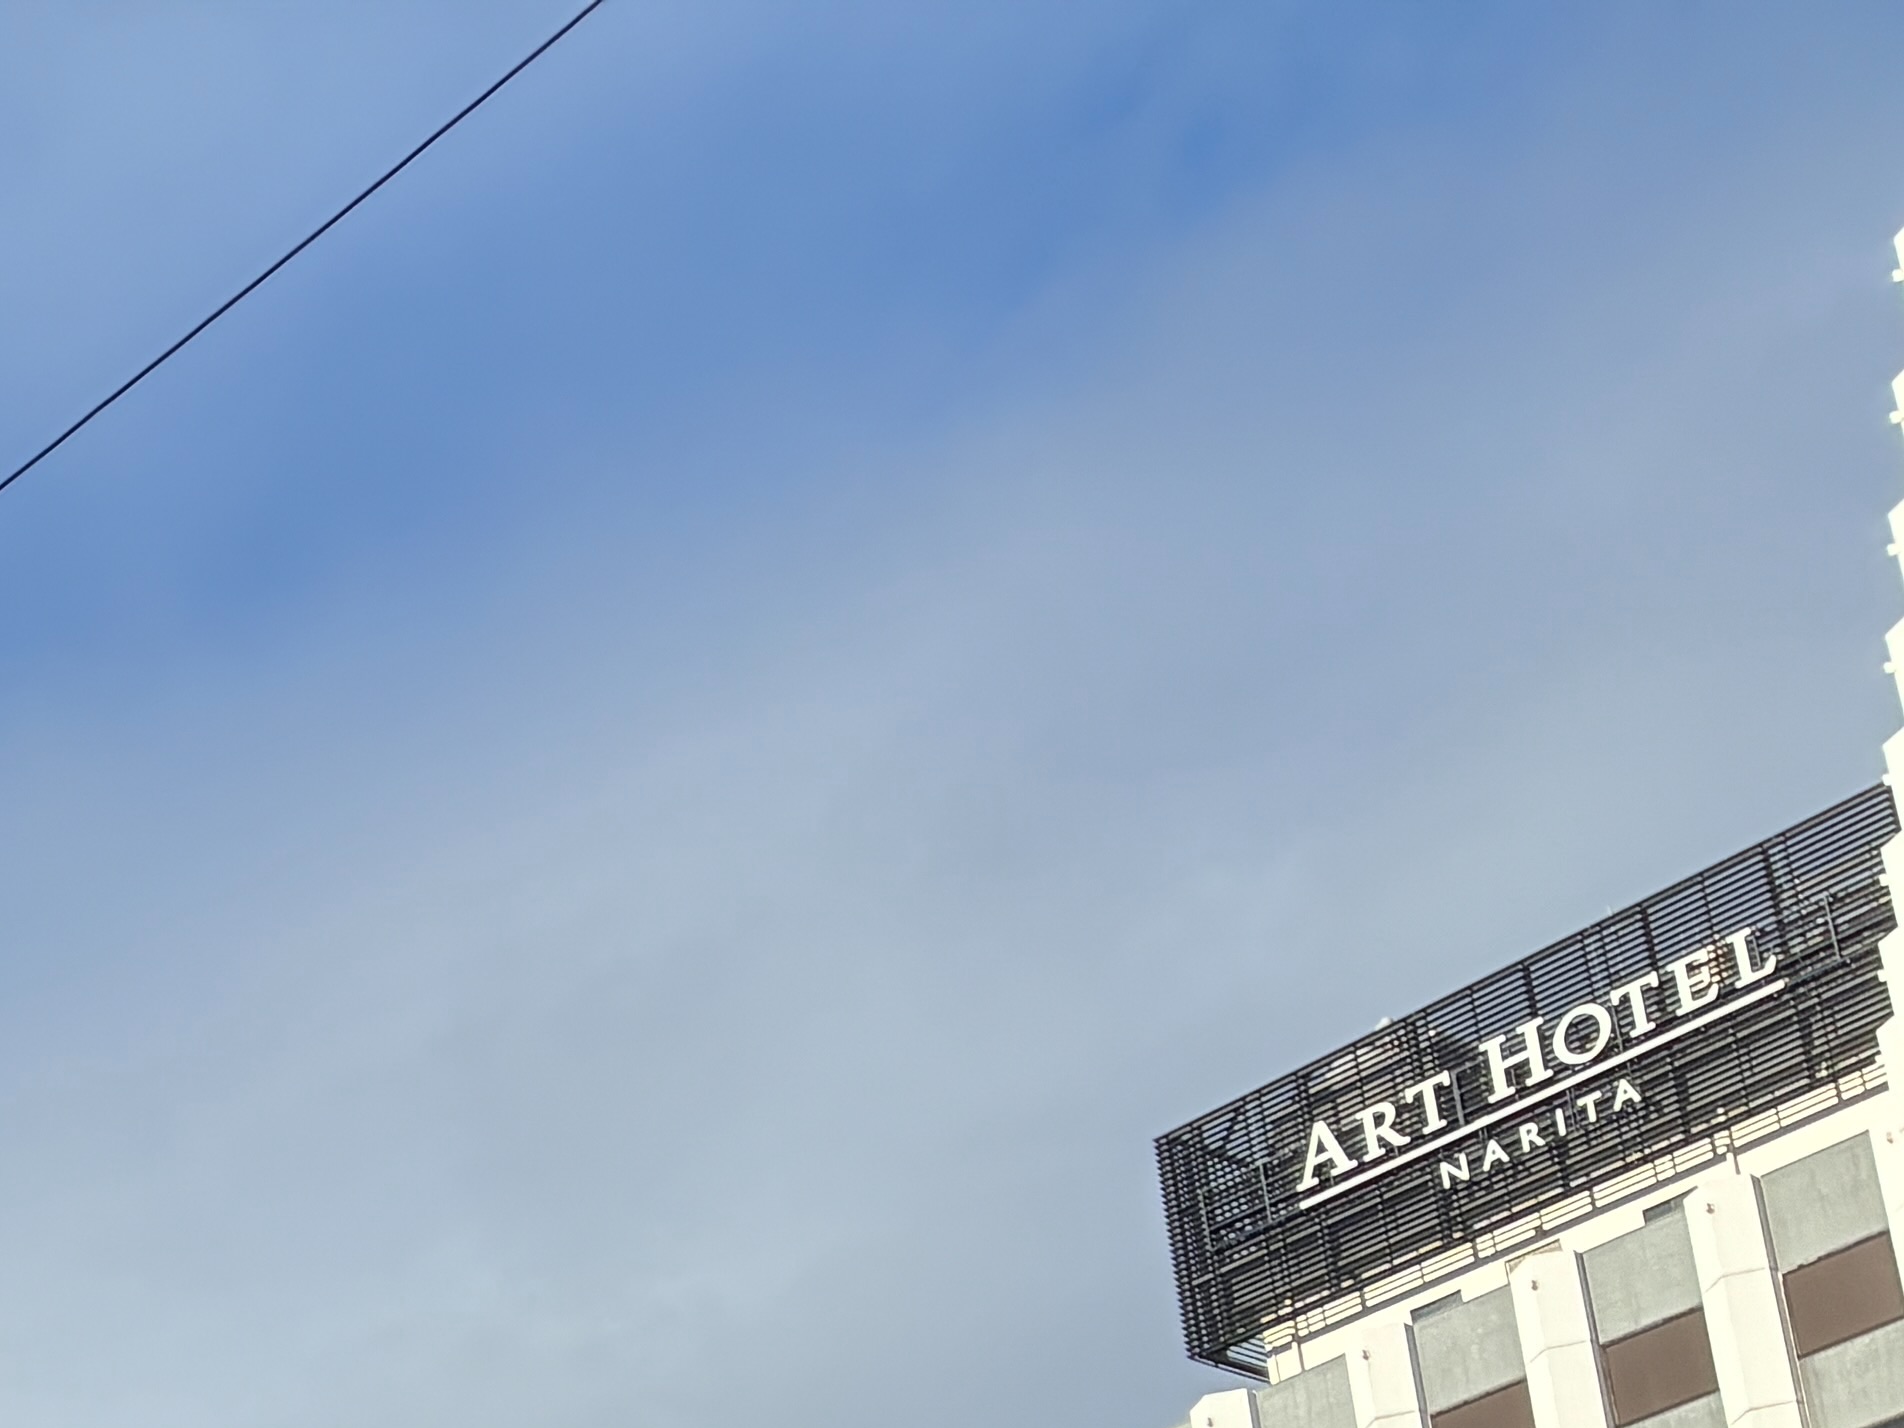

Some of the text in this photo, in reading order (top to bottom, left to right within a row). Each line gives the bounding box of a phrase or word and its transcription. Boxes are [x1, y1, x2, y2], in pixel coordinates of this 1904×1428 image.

[1296, 927, 1778, 1191] ART HOTEL
[1440, 1078, 1642, 1189] NARITA
